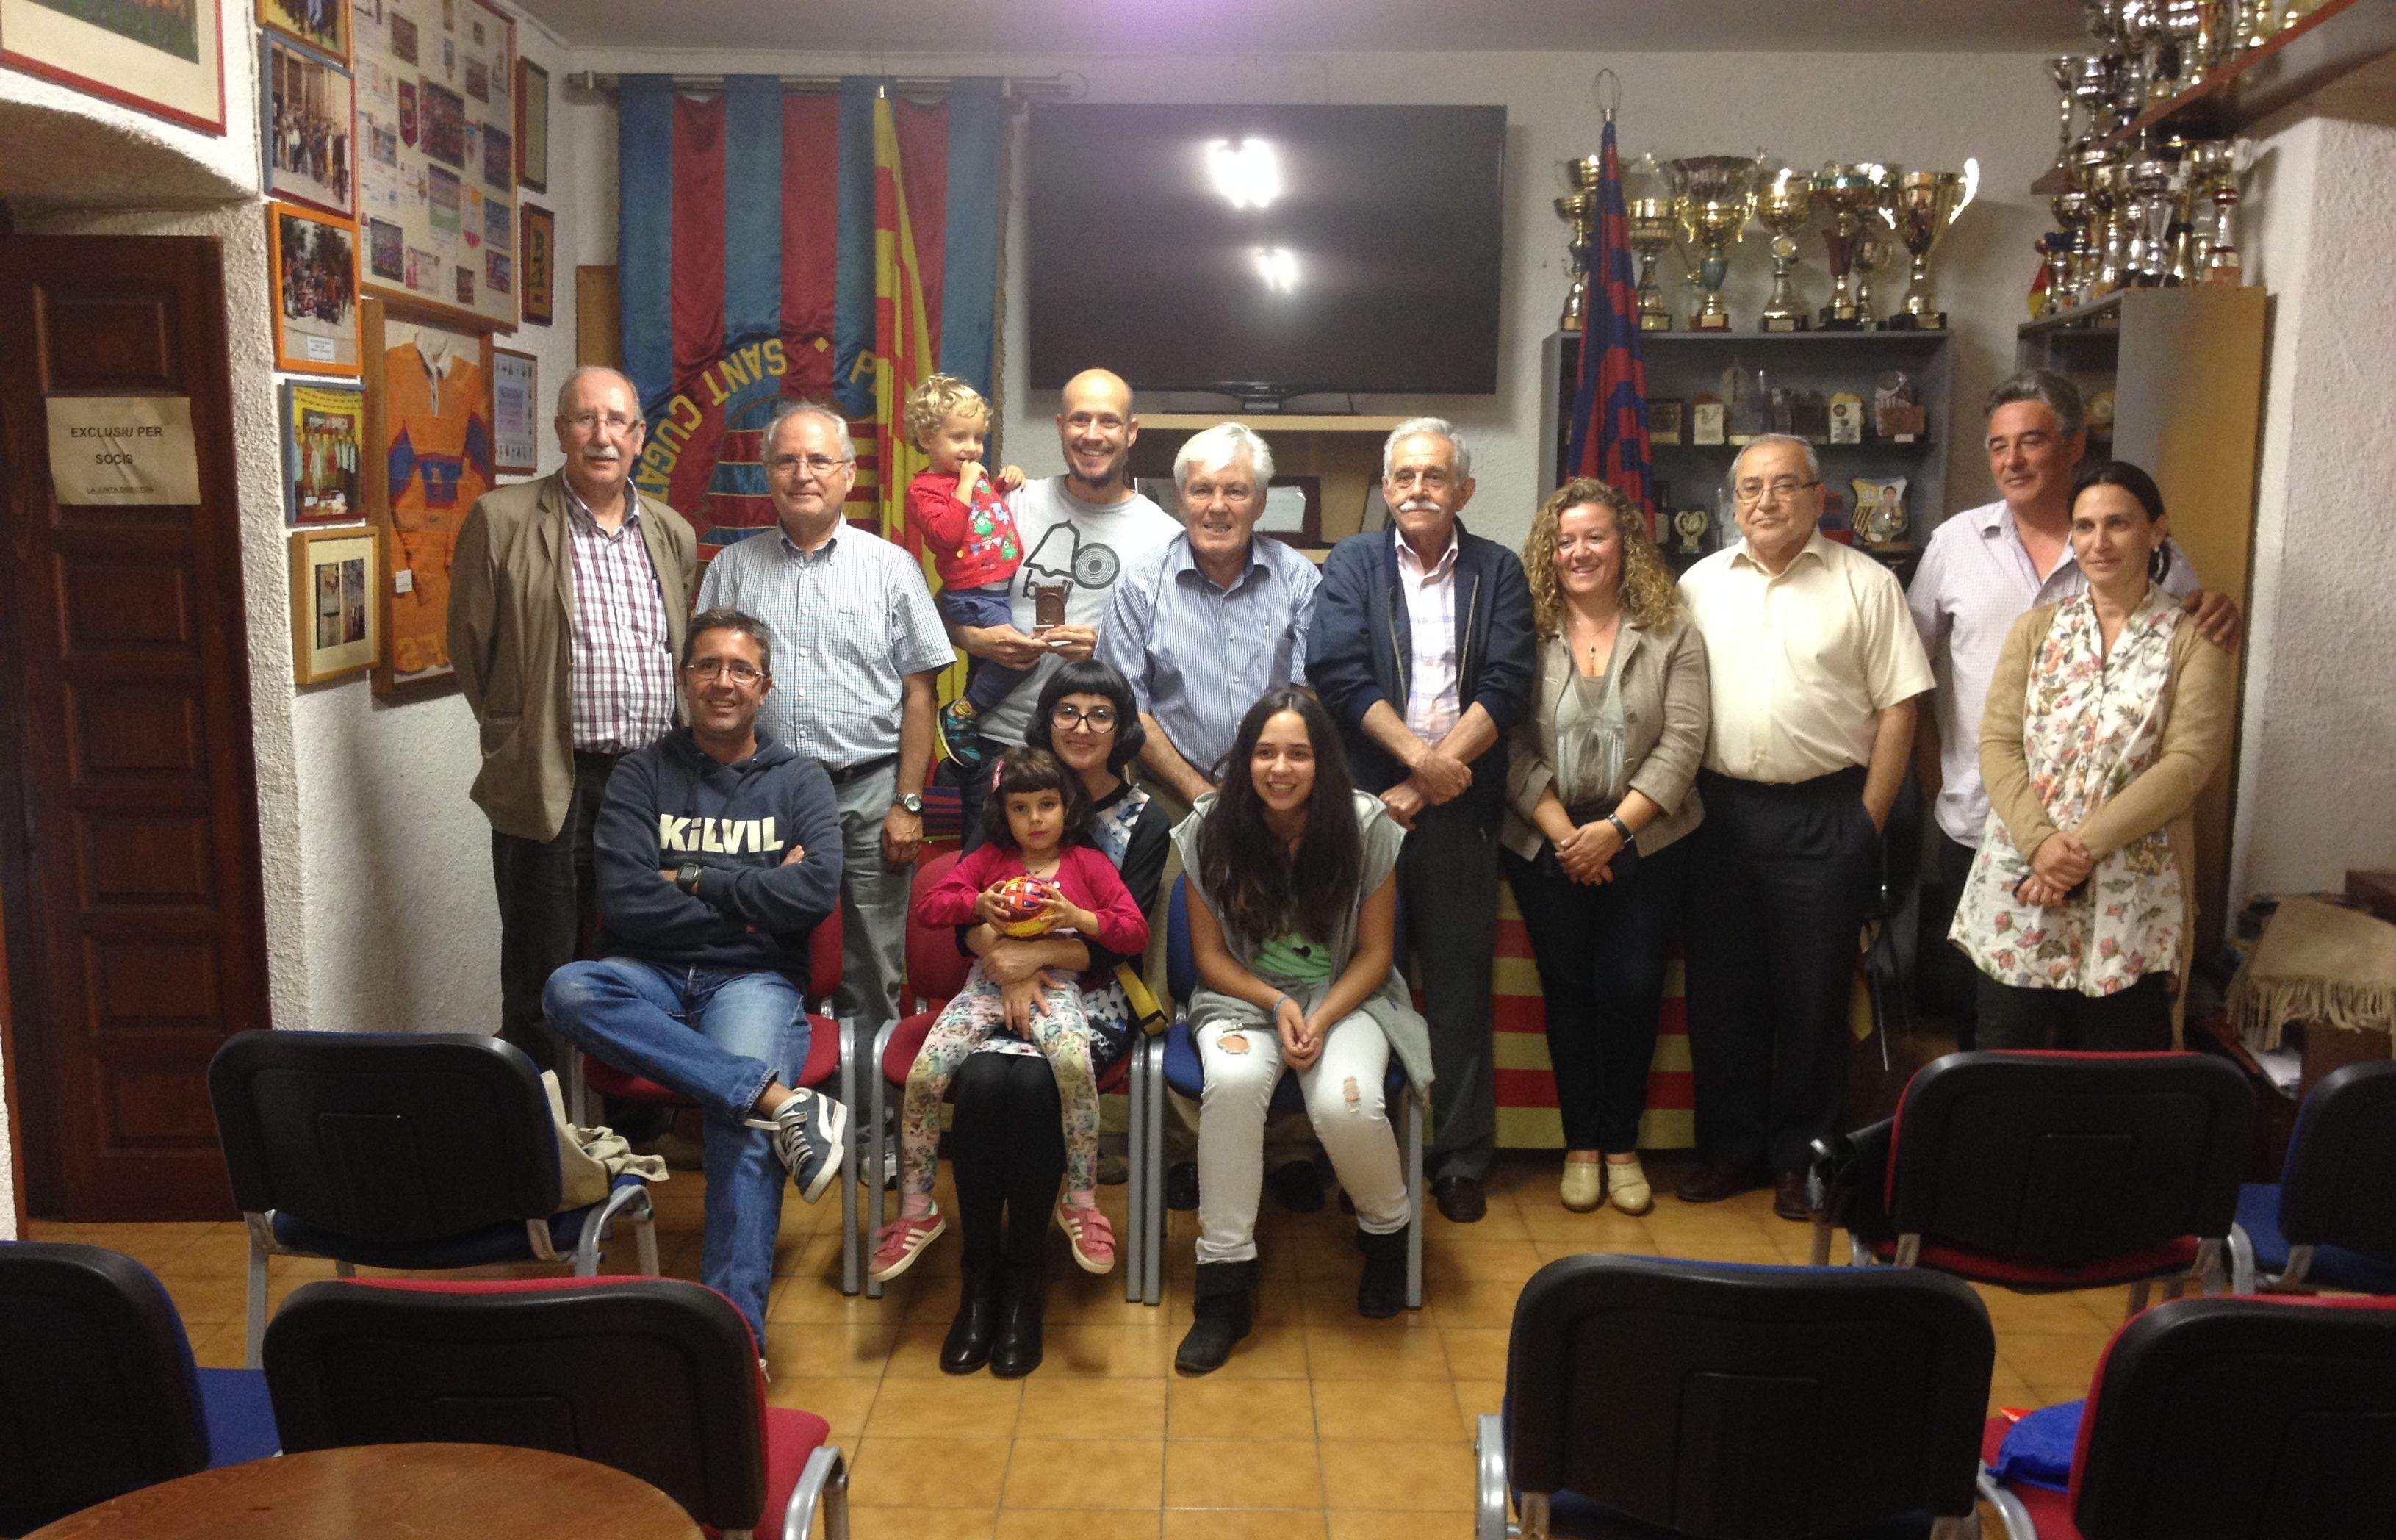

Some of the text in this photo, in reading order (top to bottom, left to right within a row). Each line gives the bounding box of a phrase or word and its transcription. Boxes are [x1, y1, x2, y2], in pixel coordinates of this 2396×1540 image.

[702, 339, 787, 406] SANT
[71, 427, 162, 438] EXCLUSIU PER
[96, 454, 133, 464] SOCIS
